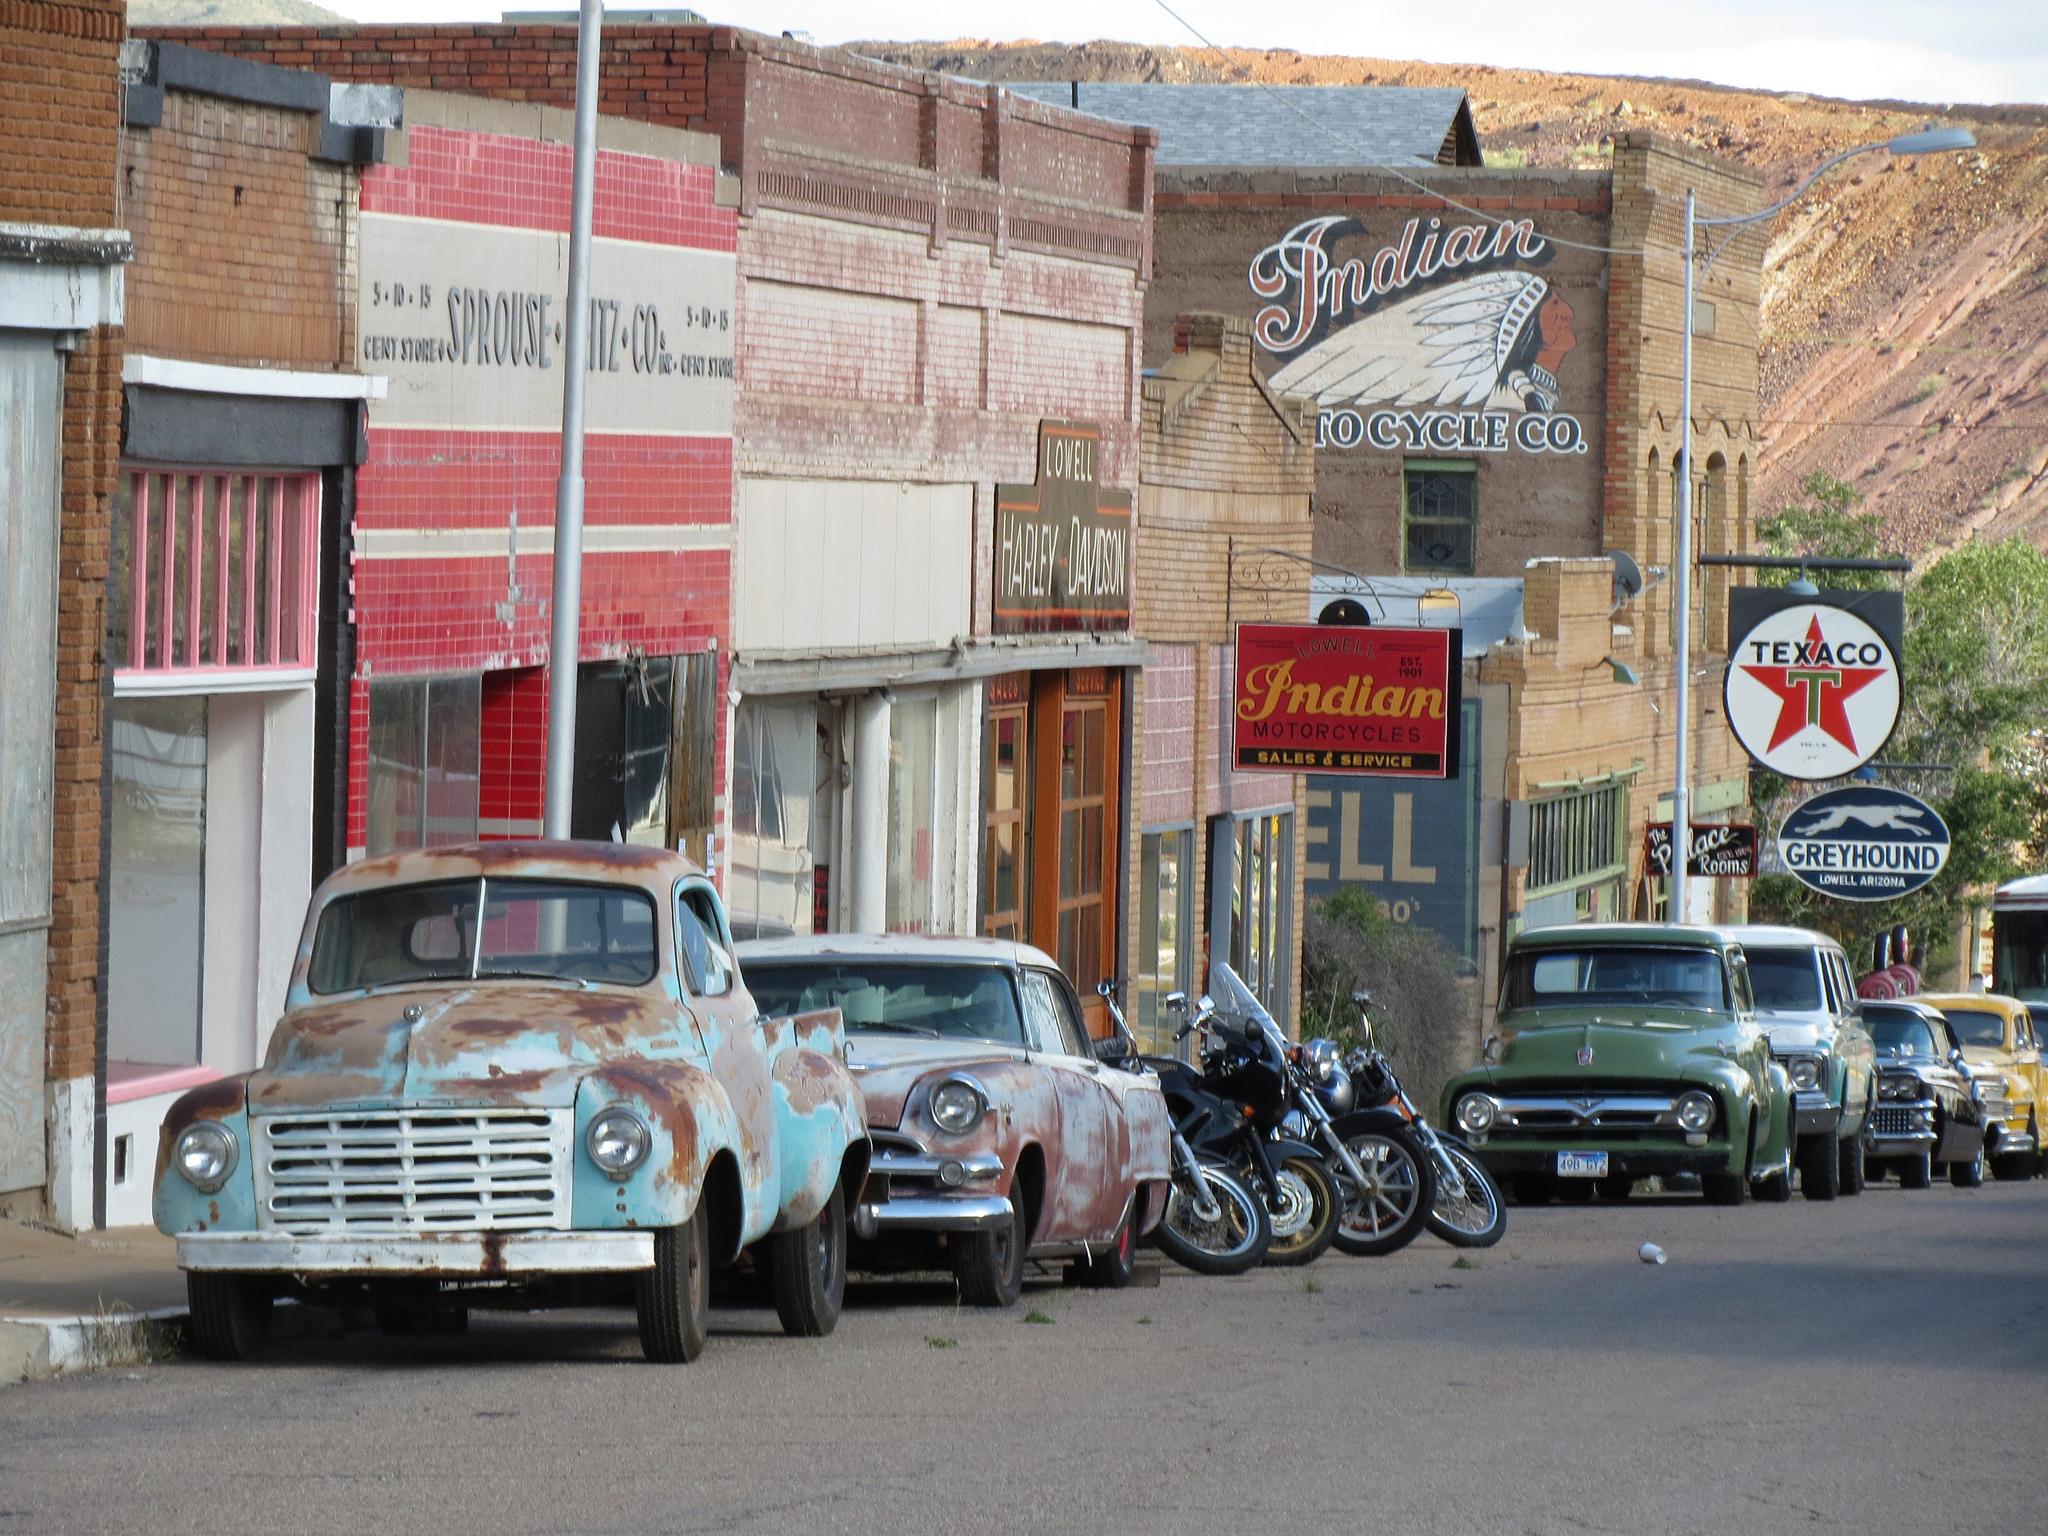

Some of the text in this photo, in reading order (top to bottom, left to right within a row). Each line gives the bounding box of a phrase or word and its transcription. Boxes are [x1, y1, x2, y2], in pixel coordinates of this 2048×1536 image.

[1248, 214, 1546, 353] Indian
[446, 286, 552, 369] SPROUSE
[364, 335, 438, 363] CENT STORE
[681, 354, 705, 377] CENT
[1516, 413, 1589, 454] CO.
[1046, 437, 1093, 482] LOWELL
[1001, 512, 1127, 597] HARLEY DAVIDSON
[1299, 635, 1376, 660] LOWELL
[1750, 641, 1883, 666] TEXACO
[1399, 667, 1422, 678] 1901
[1400, 655, 1423, 667] EST.
[1237, 658, 1446, 721] Indian
[1786, 669, 1842, 728] T
[1252, 720, 1422, 743] MOTORCYCLES
[1257, 751, 1413, 768] SALES & SERVICE
[1648, 827, 1669, 846] The
[1651, 826, 1739, 875] Place
[1785, 842, 1940, 872] GREYHOUND
[1699, 853, 1754, 875] Rooms
[1819, 873, 1907, 889] LOWELL ARIZONA
